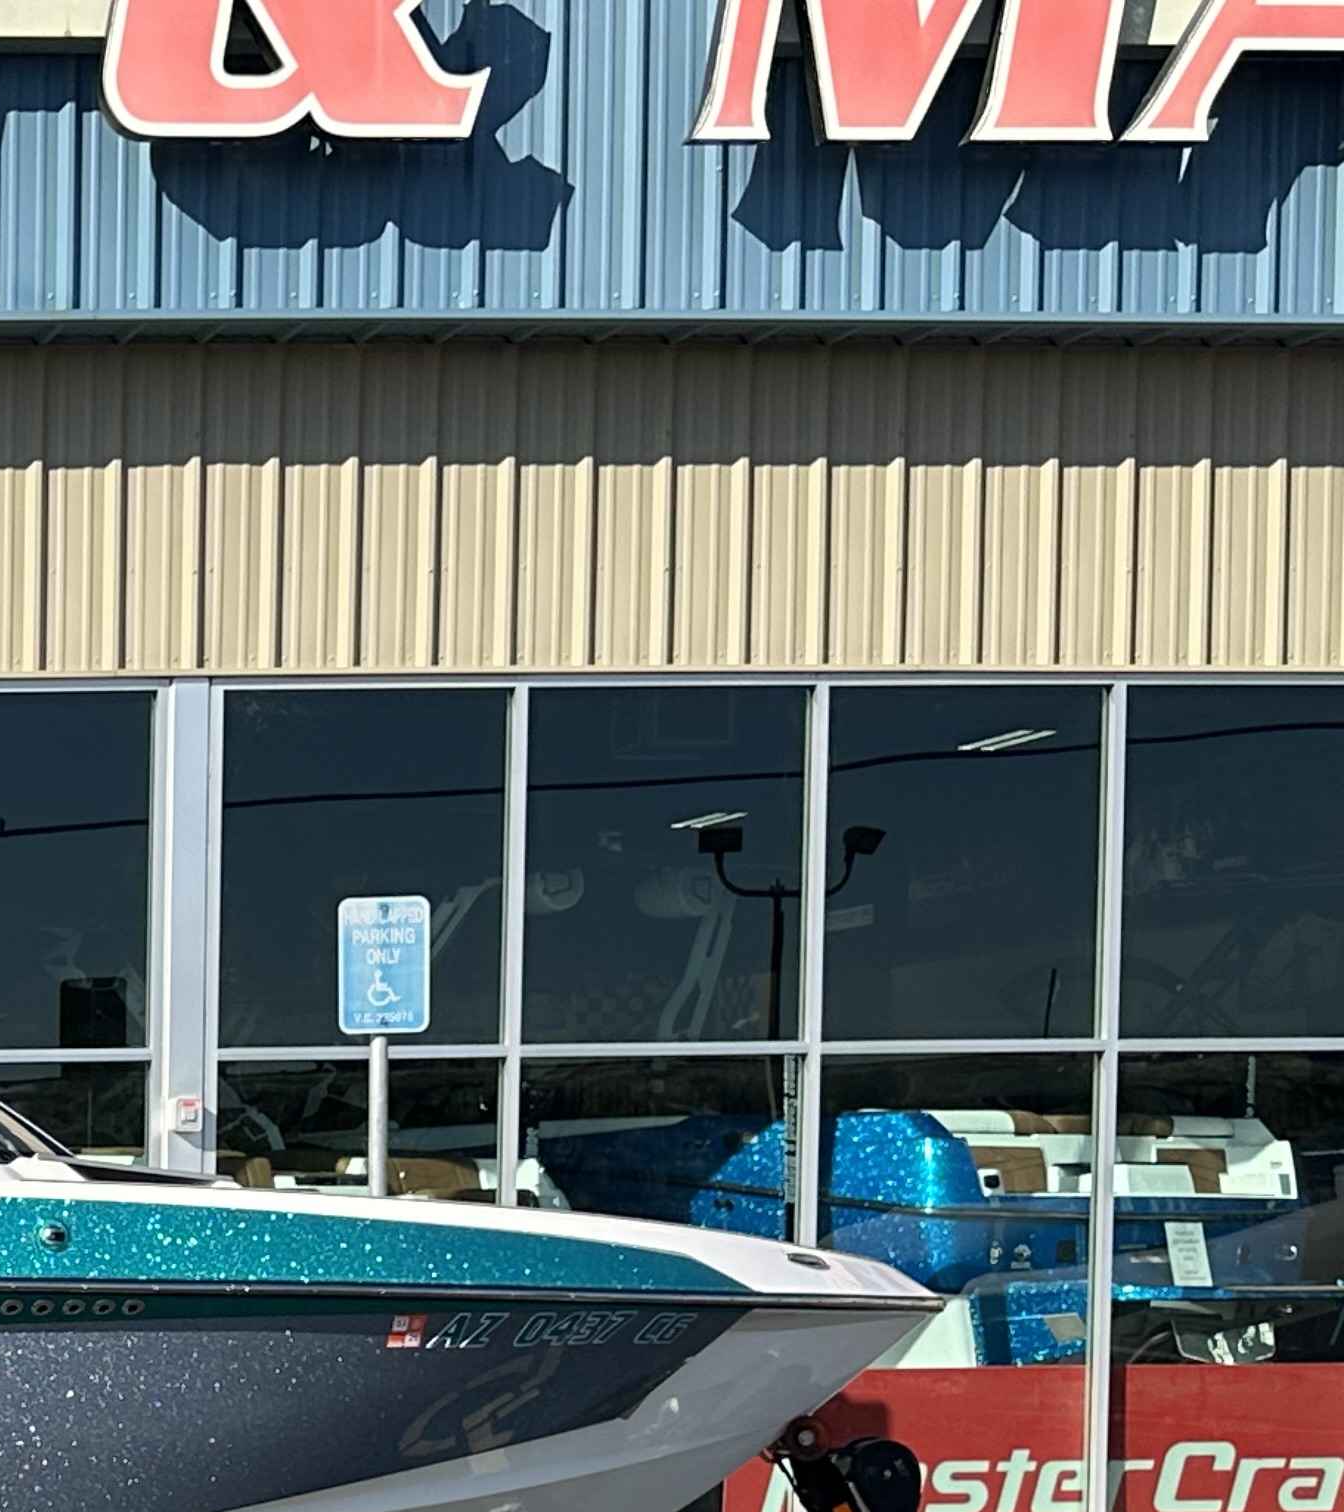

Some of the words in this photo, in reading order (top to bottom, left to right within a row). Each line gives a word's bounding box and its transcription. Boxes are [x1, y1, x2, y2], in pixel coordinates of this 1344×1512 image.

[352, 927, 416, 945] PARKING
[366, 947, 401, 965] ONLY
[425, 1312, 511, 1348] AZ
